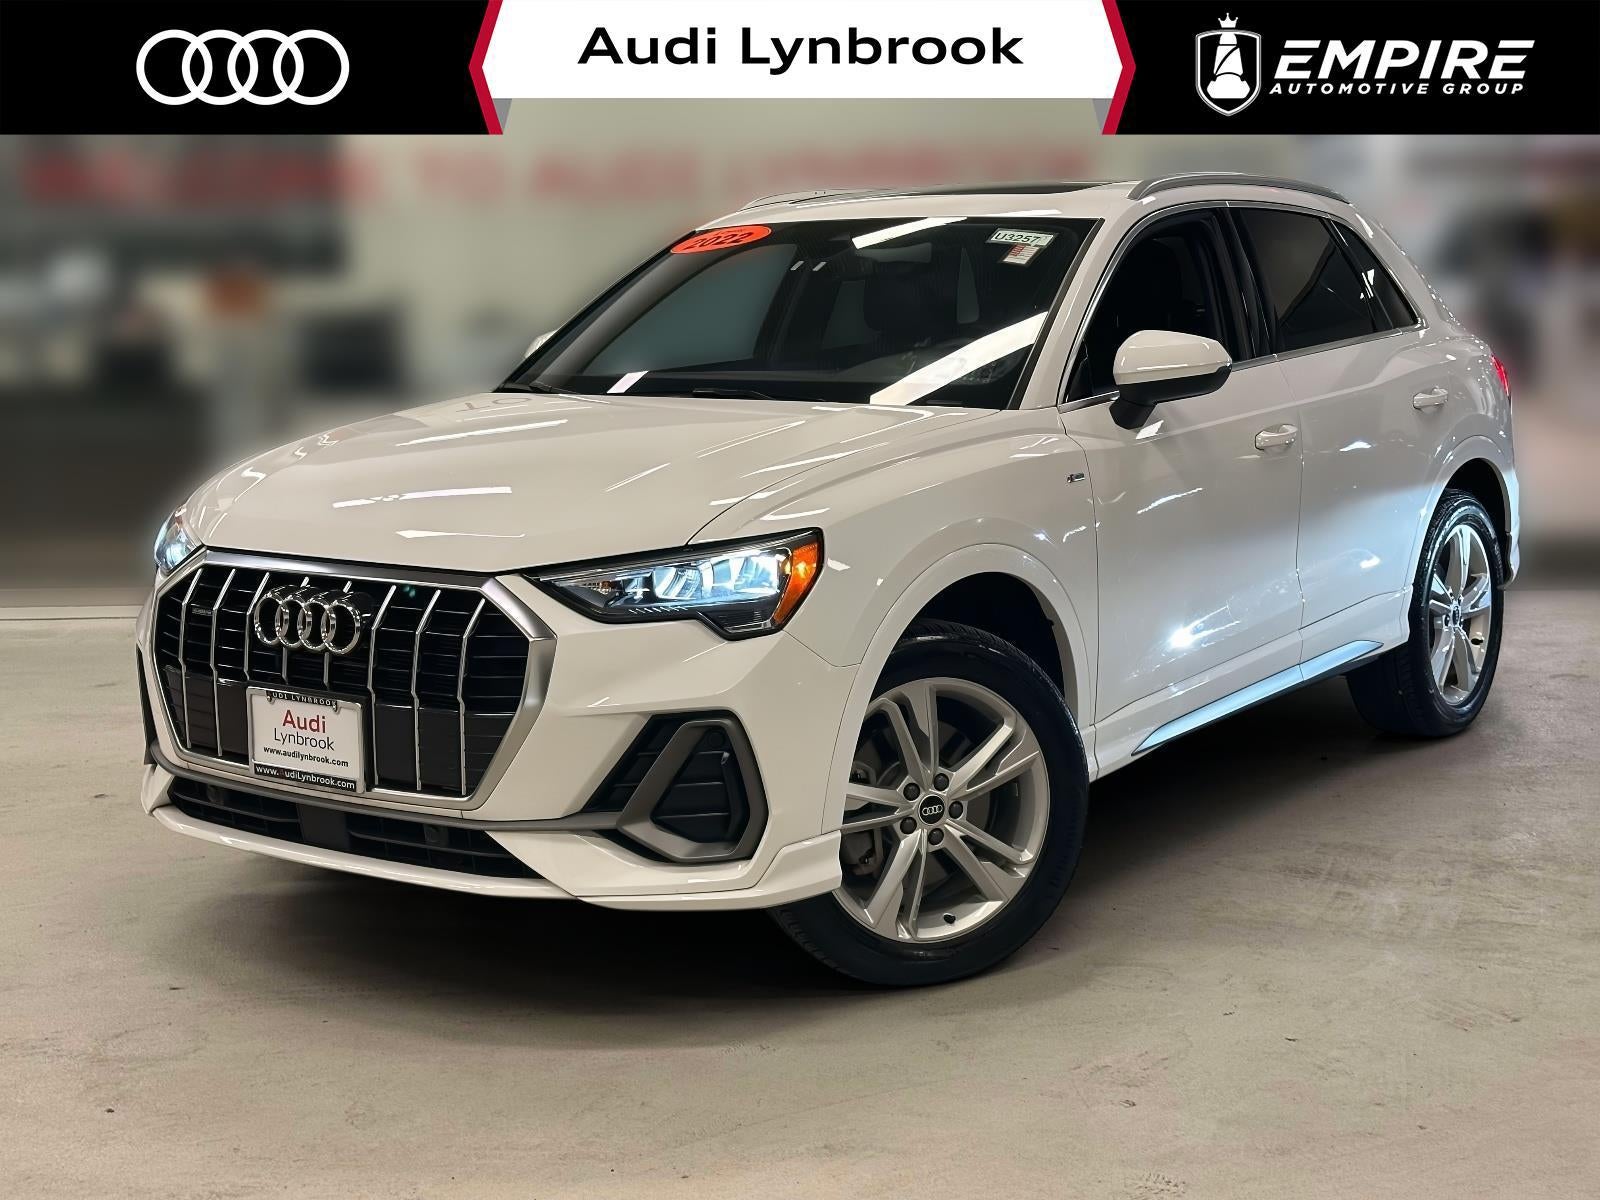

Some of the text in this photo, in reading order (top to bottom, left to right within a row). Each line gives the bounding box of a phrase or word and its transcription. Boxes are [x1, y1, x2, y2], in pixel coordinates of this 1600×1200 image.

[683, 231, 754, 250] 2022
[282, 709, 326, 733] Audi
[274, 727, 335, 751] Lynbrook
[263, 746, 349, 767] www.audilynbrook.com
